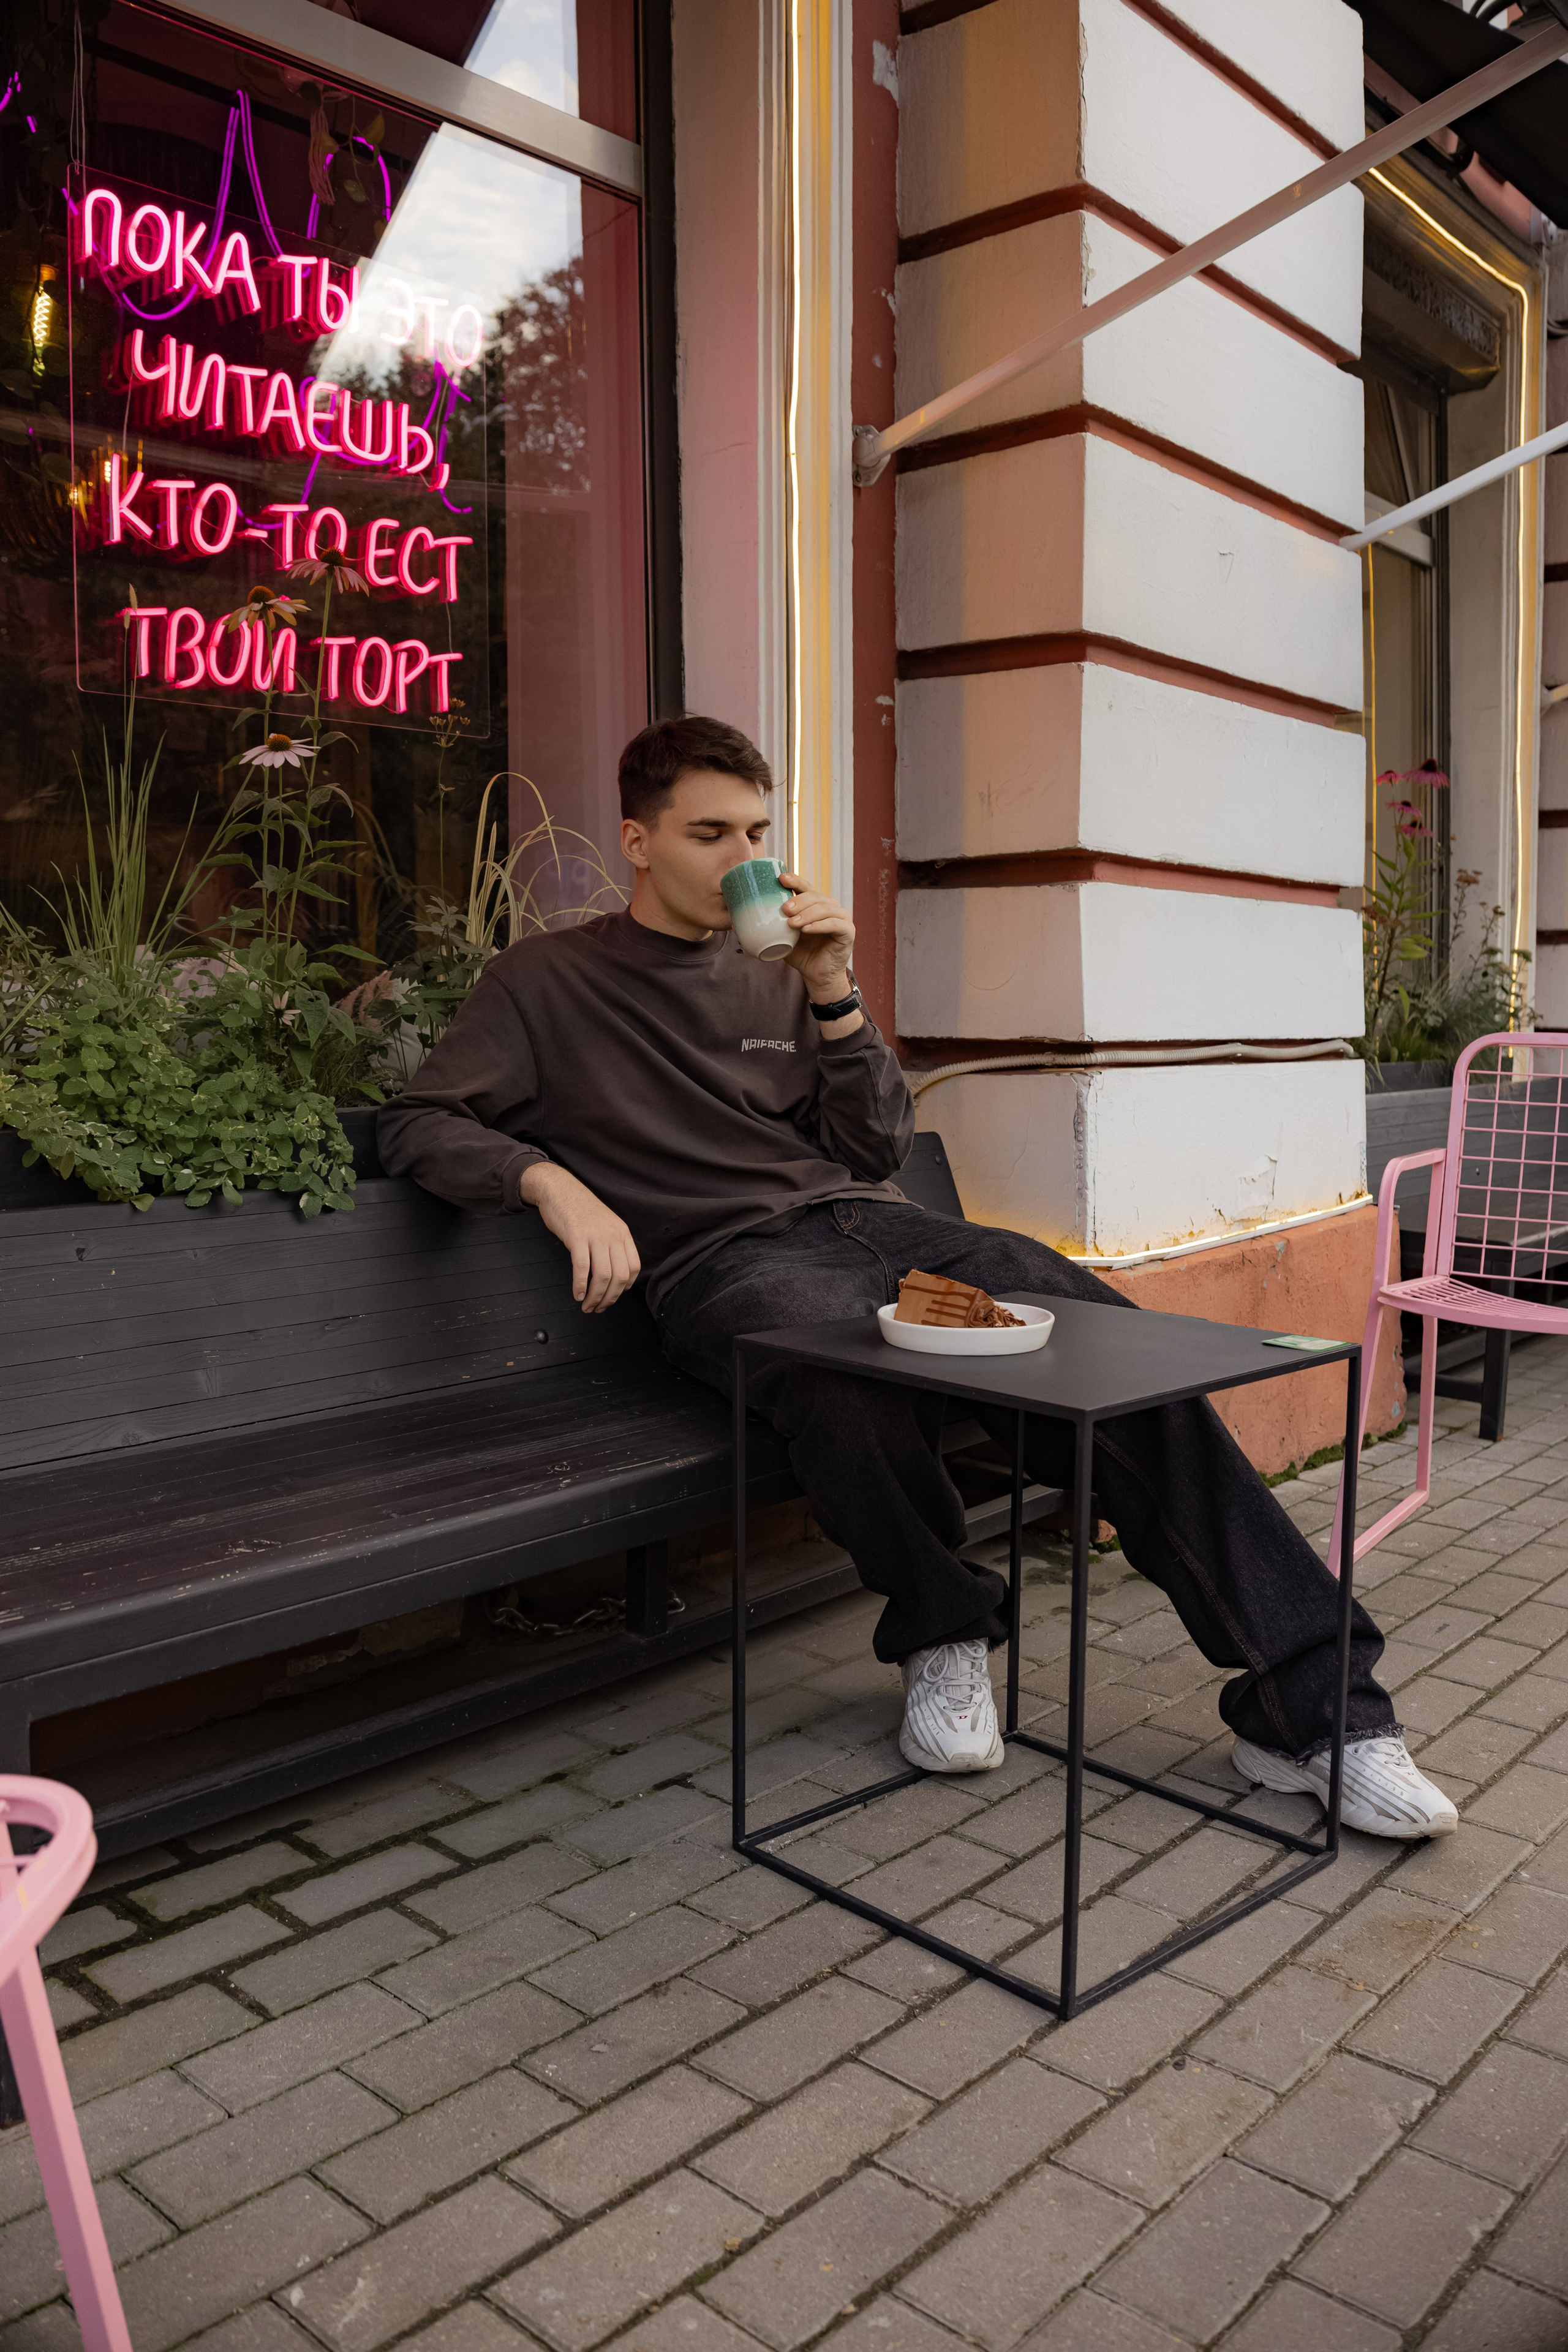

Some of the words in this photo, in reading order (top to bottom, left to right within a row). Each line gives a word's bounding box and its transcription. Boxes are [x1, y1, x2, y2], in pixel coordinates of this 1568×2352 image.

[82, 189, 262, 314] ПОКА
[270, 255, 361, 334] ТЫ
[380, 278, 484, 368] ЭТО
[132, 329, 450, 492] ЧИТАЕШЬ,
[104, 454, 347, 570] КТО-ТО
[366, 518, 473, 603] ЕСТ
[311, 636, 463, 714] ТОРТ
